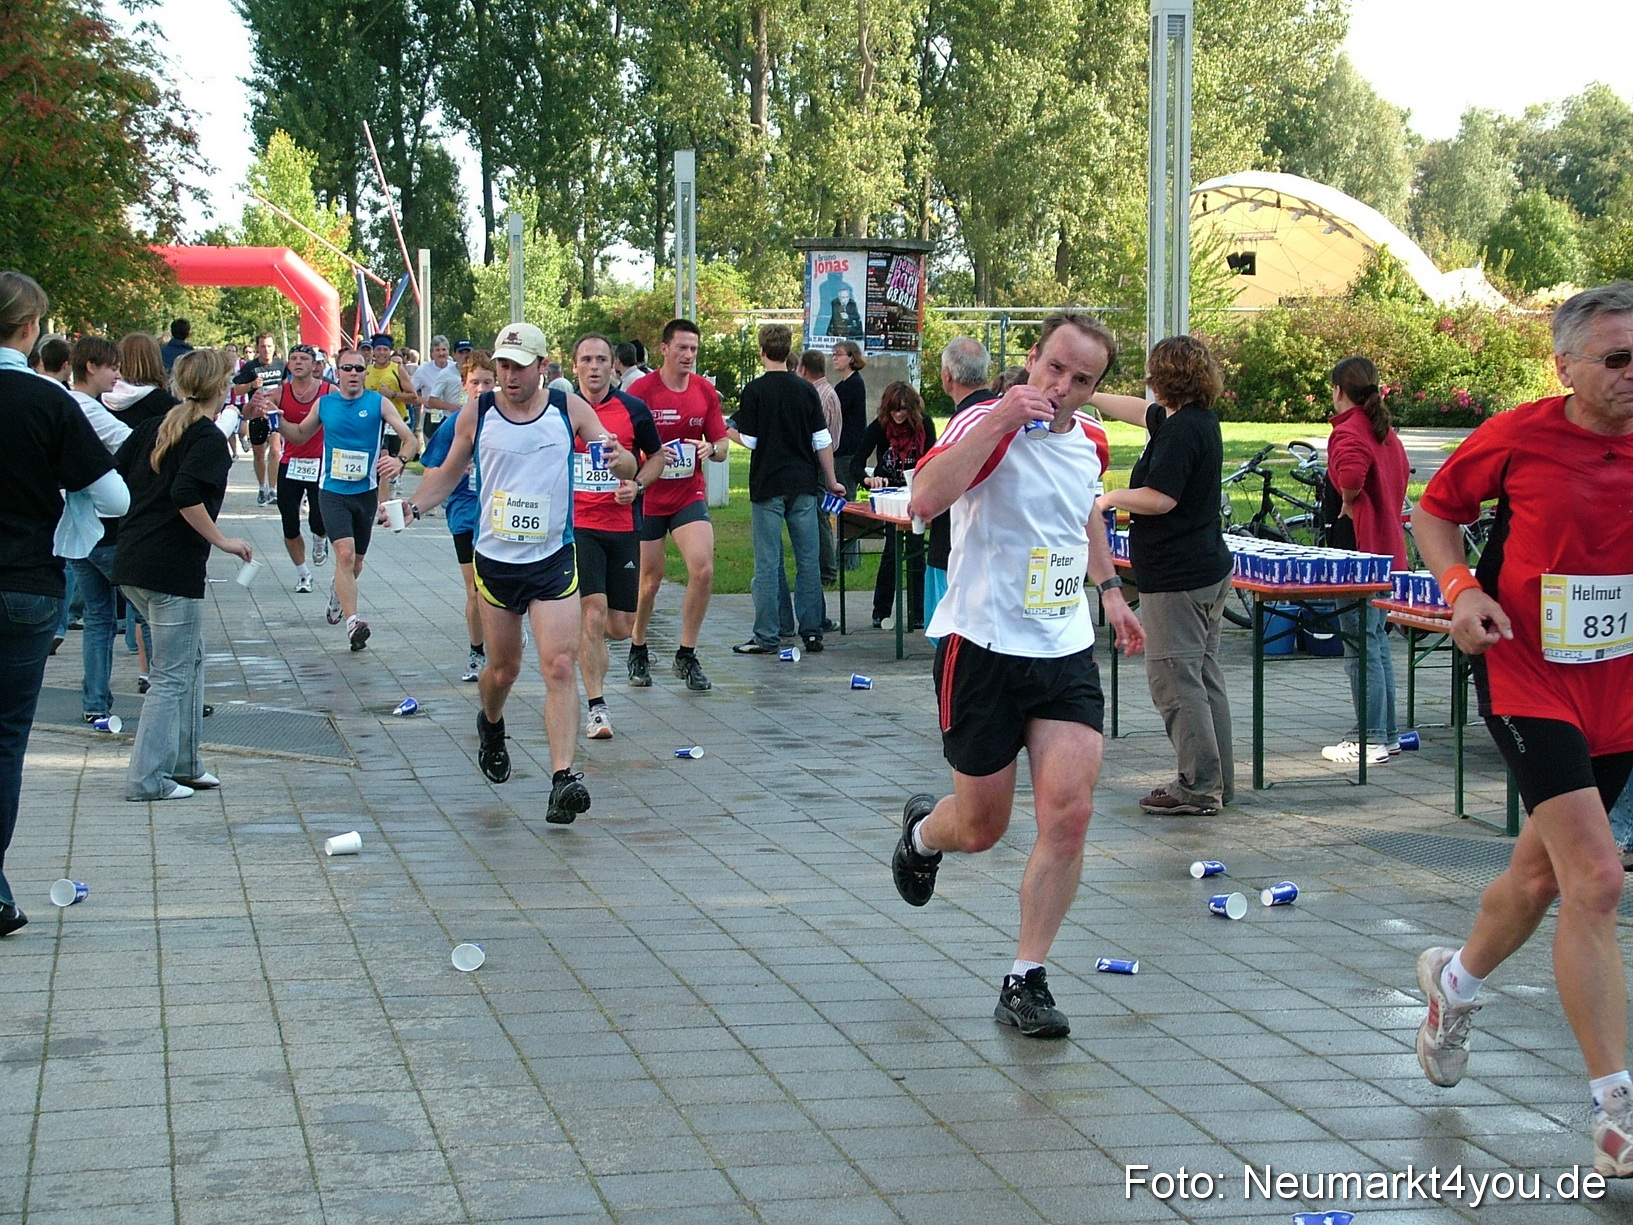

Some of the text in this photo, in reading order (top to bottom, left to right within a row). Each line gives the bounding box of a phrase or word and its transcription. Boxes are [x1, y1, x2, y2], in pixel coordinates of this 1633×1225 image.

[344, 463, 362, 473] 124
[669, 457, 692, 469] 043
[296, 466, 317, 475] 2362
[586, 470, 617, 482] 2892
[506, 496, 540, 509] Andreas
[511, 515, 540, 530] 856
[1050, 553, 1075, 567] Peter
[1031, 574, 1037, 585] B
[1054, 576, 1080, 597] 908
[1571, 584, 1622, 601] Helmut
[1545, 608, 1553, 621] B
[1583, 611, 1628, 639] 831
